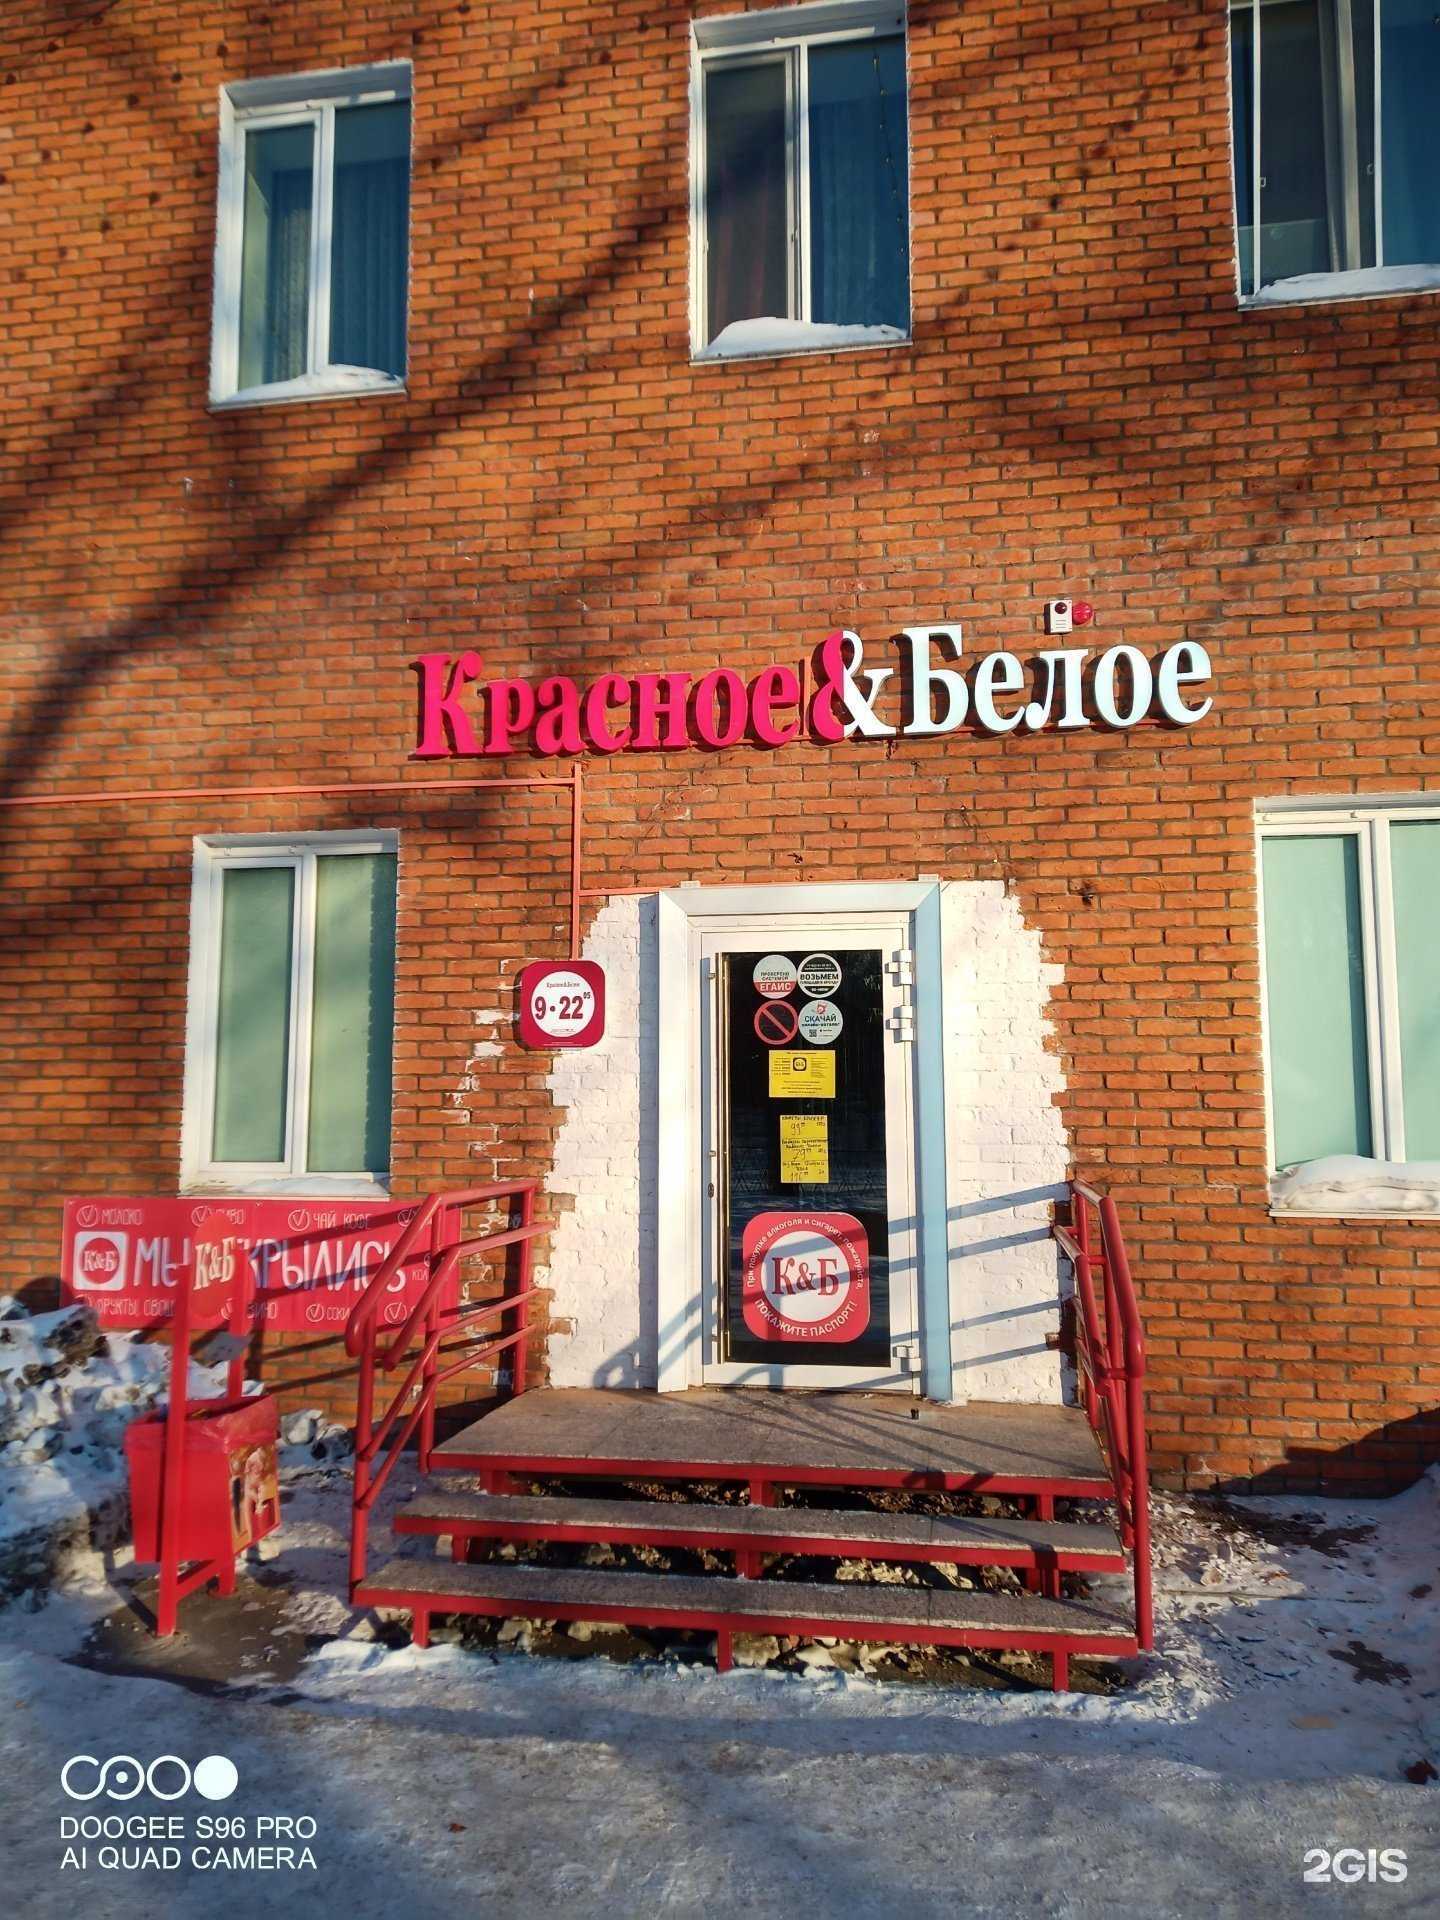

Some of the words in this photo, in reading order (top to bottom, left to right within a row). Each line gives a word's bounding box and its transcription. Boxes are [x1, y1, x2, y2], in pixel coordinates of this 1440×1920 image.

[760, 982, 792, 992] ЕГАИС
[799, 973, 839, 981] ВОЗЬМЕМ
[804, 1013, 837, 1022] СКАЧАЙ
[101, 1208, 143, 1225] МОЛОКО
[82, 1250, 117, 1272] К&Б
[193, 1236, 235, 1291] К&Б
[747, 1268, 756, 1287] При
[766, 1218, 803, 1238] алкоголя
[771, 1257, 839, 1296] К&Б
[755, 1299, 808, 1337] ПОКАЖИТЕ
[809, 1300, 858, 1337] ПАСПОРТ!
